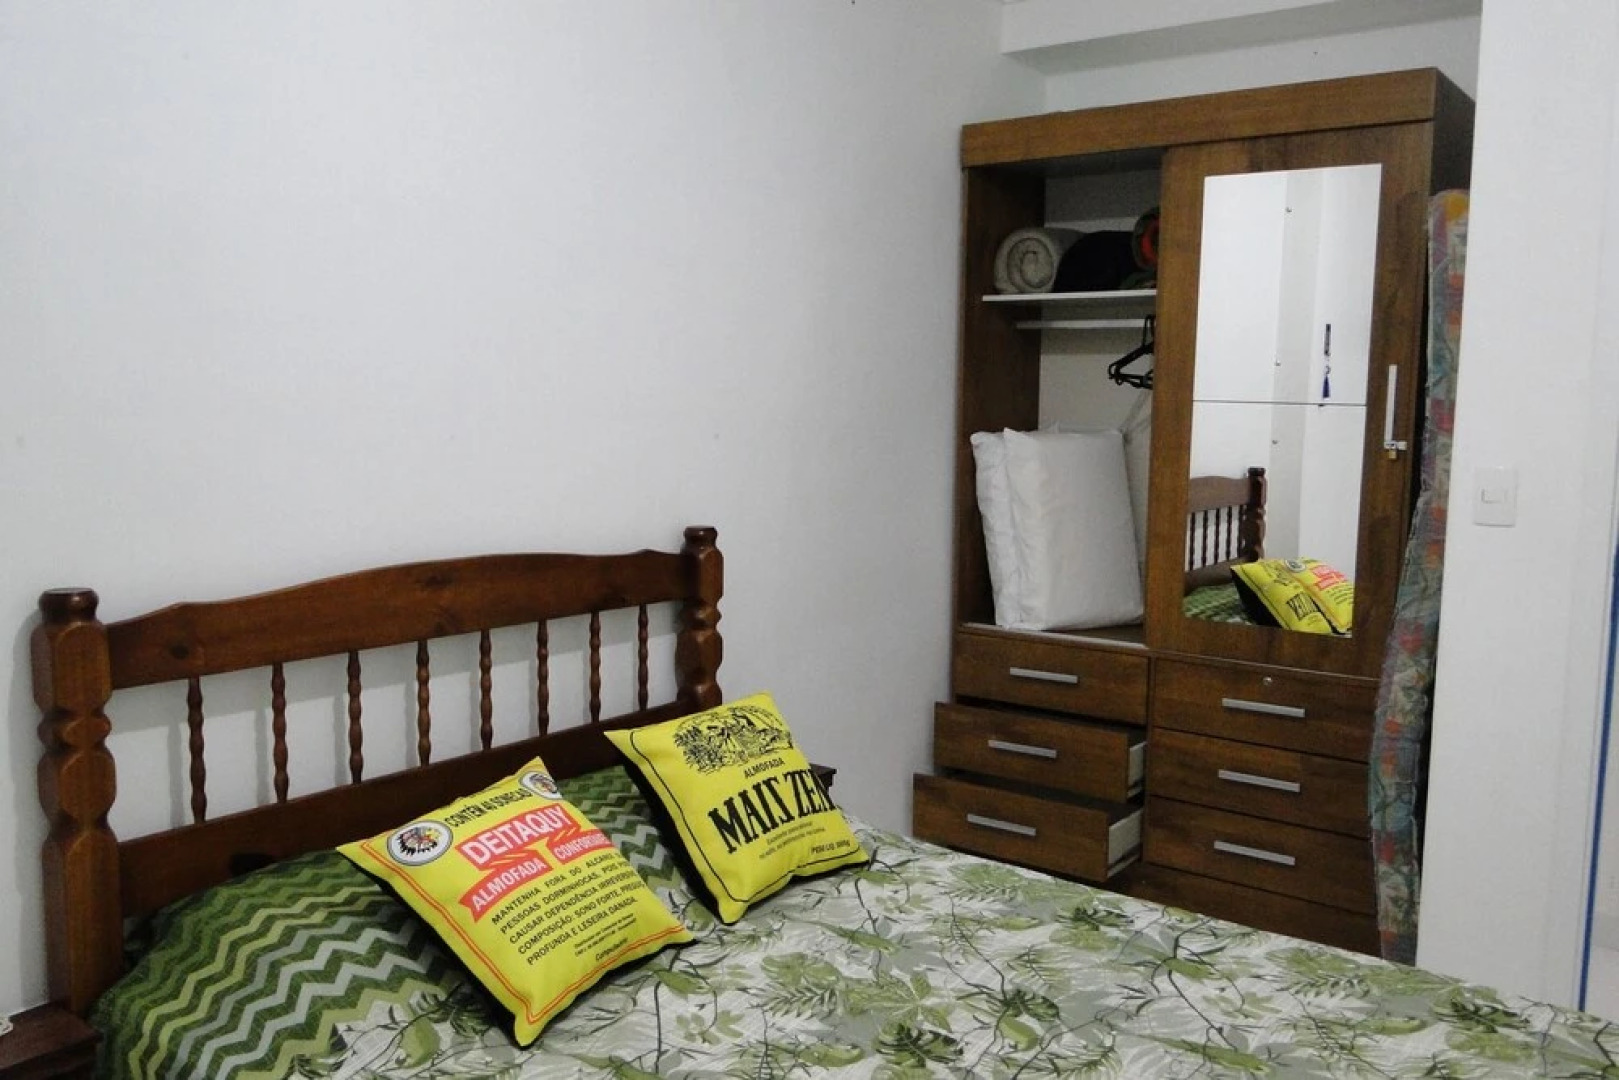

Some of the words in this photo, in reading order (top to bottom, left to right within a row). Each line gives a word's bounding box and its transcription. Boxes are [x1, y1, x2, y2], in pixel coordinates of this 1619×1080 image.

[462, 807, 572, 865] DEITAQUY
[708, 776, 795, 854] MAIS
[471, 858, 547, 911] ALMOFADA
[492, 887, 541, 925] MANTENHA
[544, 874, 567, 888] FORA
[569, 866, 581, 876] DO
[575, 902, 596, 918] SONO
[500, 902, 541, 934] PESSOAS
[510, 916, 544, 944] CAUSAR
[527, 931, 571, 965] PROFUNDA
[578, 911, 609, 931] LESEIRA
